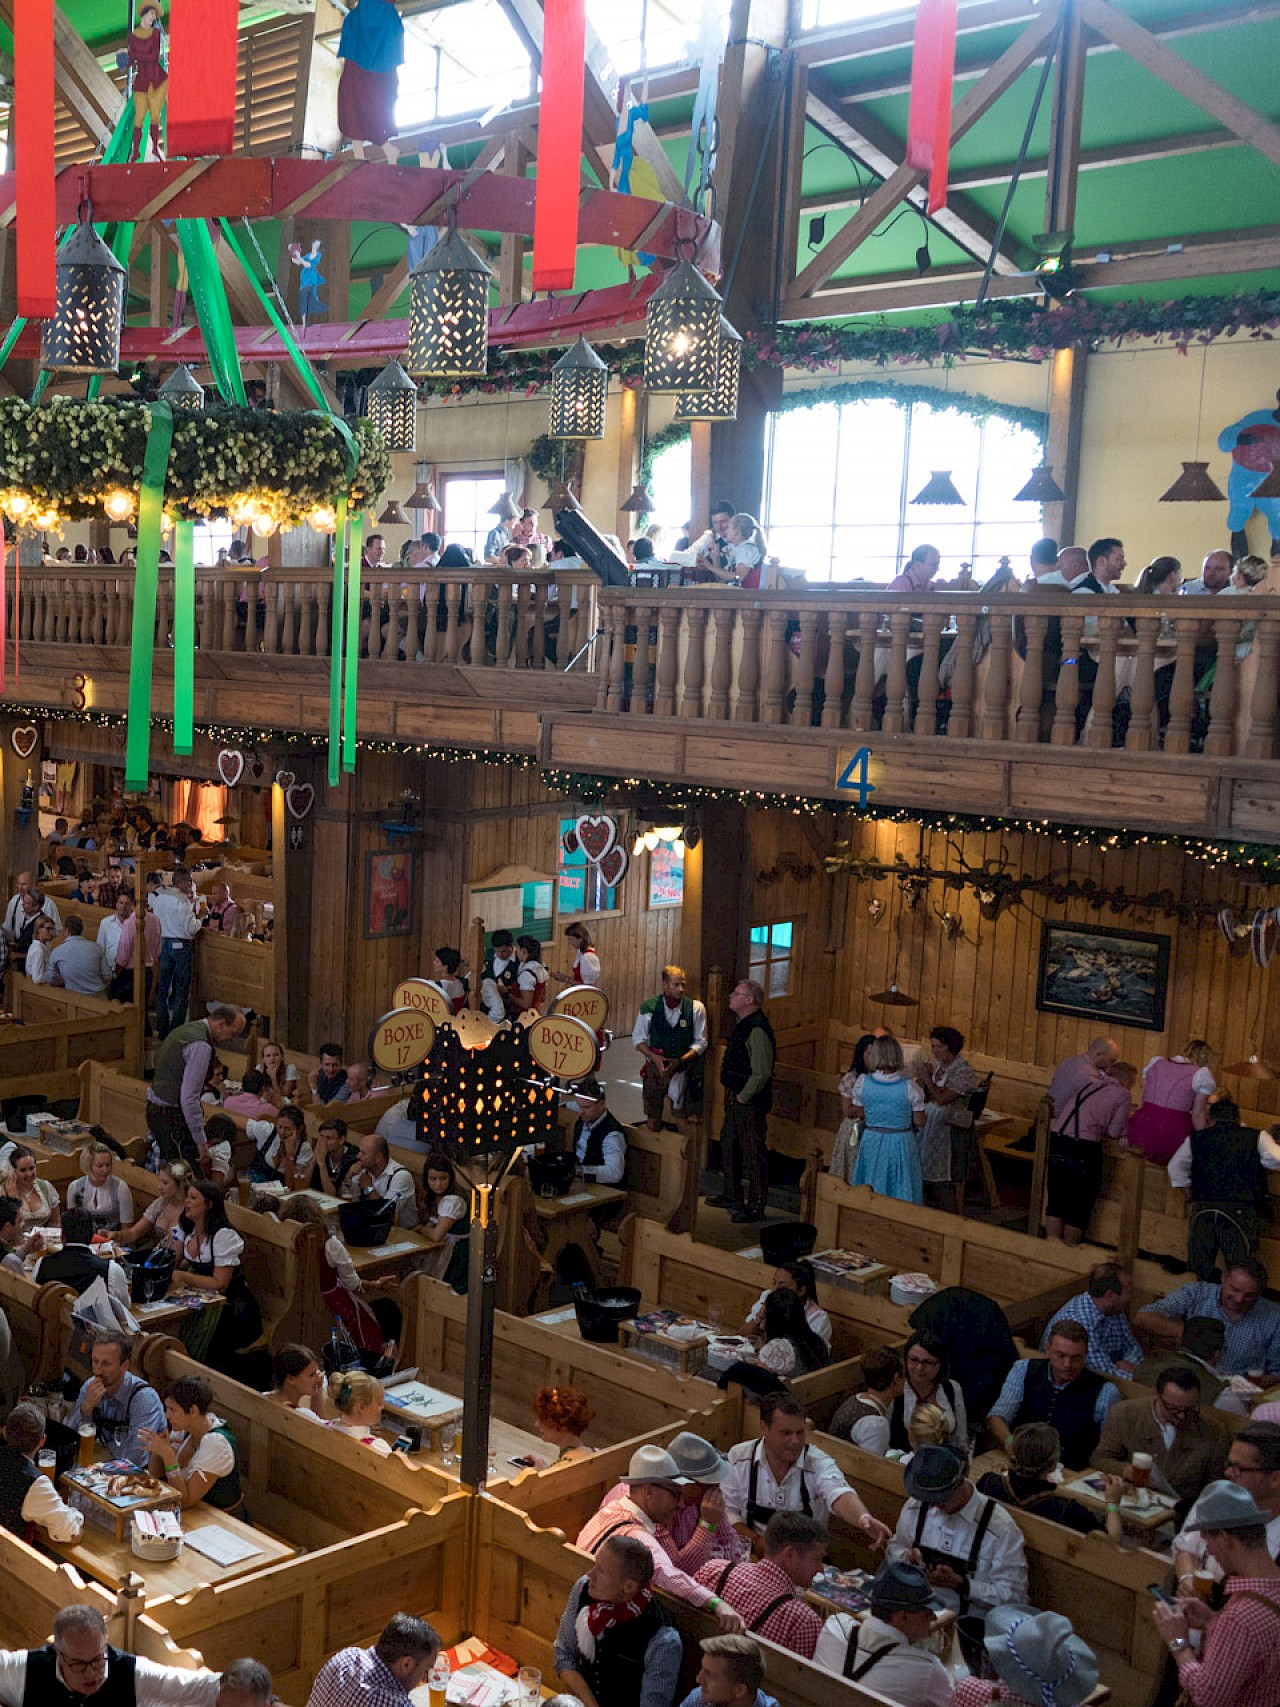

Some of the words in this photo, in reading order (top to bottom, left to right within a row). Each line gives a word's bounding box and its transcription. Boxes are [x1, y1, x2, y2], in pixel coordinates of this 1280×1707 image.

[71, 671, 86, 710] 3
[837, 747, 875, 809] 4
[402, 990, 440, 1015] BOXE
[562, 998, 599, 1017] BOXE
[383, 1022, 425, 1046] BOXE
[541, 1027, 585, 1053] BOXE
[396, 1045, 411, 1065] 17
[552, 1051, 568, 1070] 17
